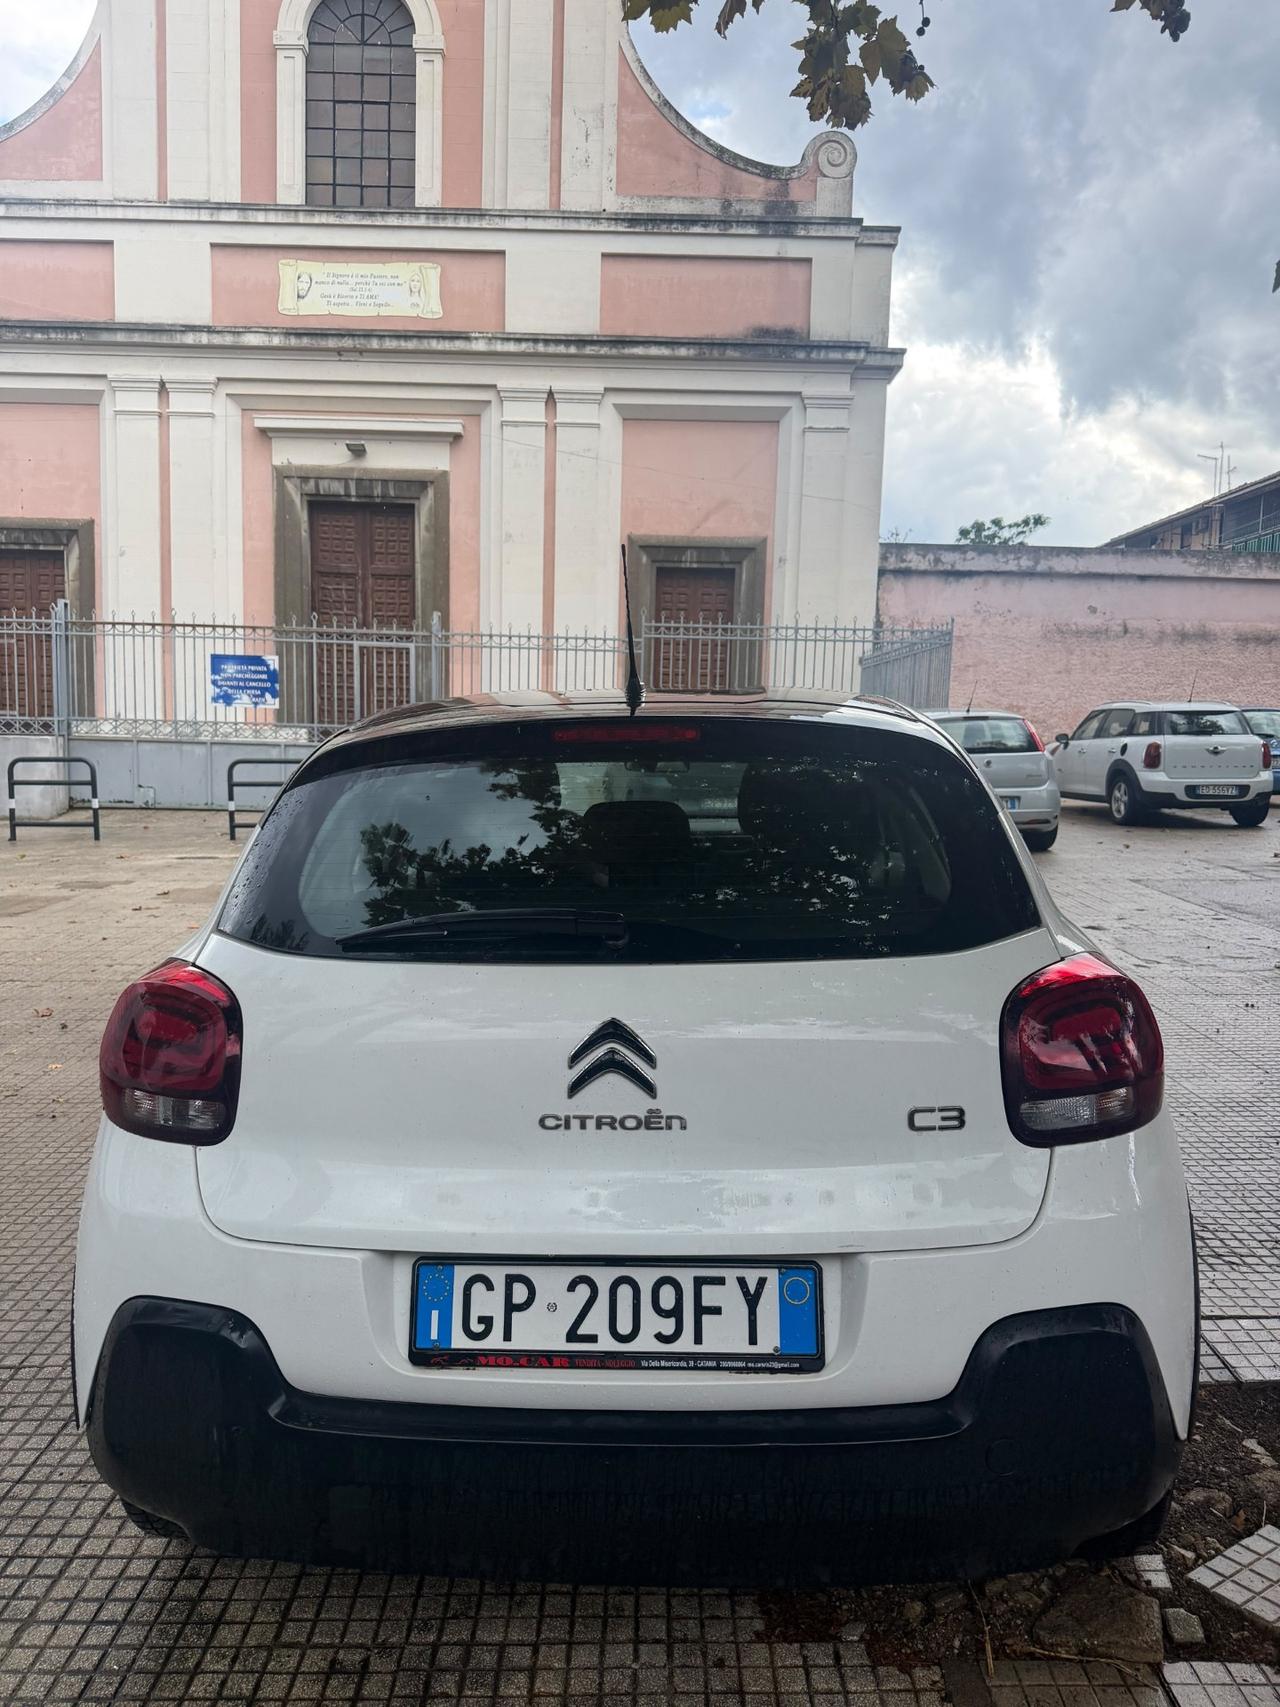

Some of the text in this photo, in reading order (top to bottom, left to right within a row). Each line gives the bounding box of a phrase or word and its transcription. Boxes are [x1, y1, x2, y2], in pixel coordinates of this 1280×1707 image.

[907, 1106, 966, 1132] C3
[461, 1273, 768, 1346] GP 209FY
